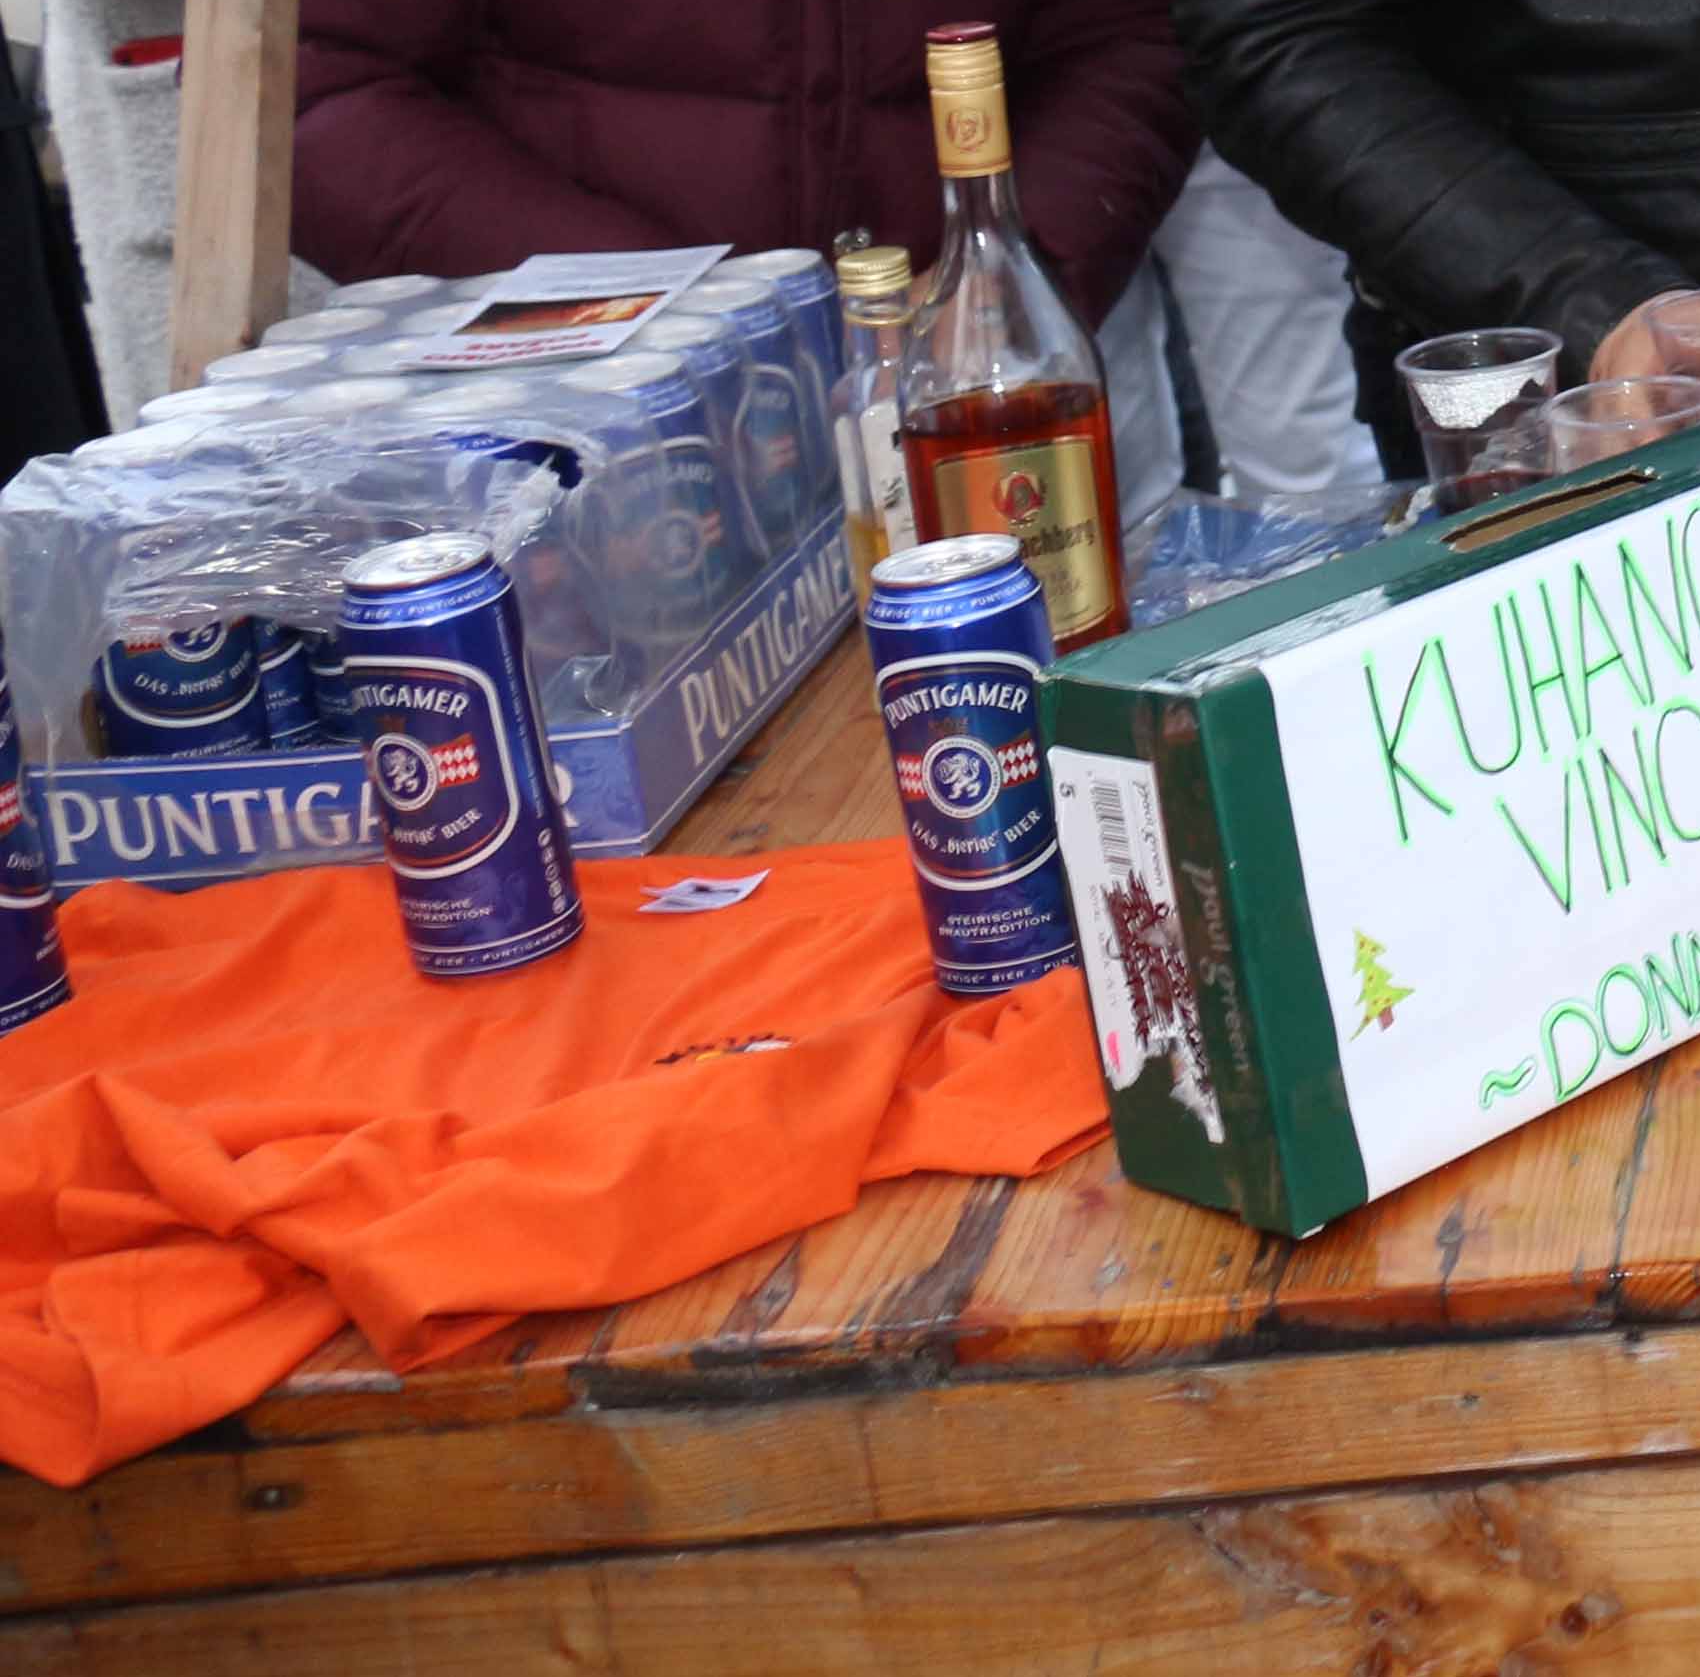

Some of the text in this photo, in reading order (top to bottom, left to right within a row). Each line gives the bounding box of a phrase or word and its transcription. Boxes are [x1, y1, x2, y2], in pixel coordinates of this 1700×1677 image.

[884, 682, 1029, 730] PUNTIGAMER
[441, 808, 485, 841] BIER
[1003, 809, 1042, 844] BIER
[946, 906, 1033, 926] STEIRISCHE
[991, 969, 1025, 983] BIER
